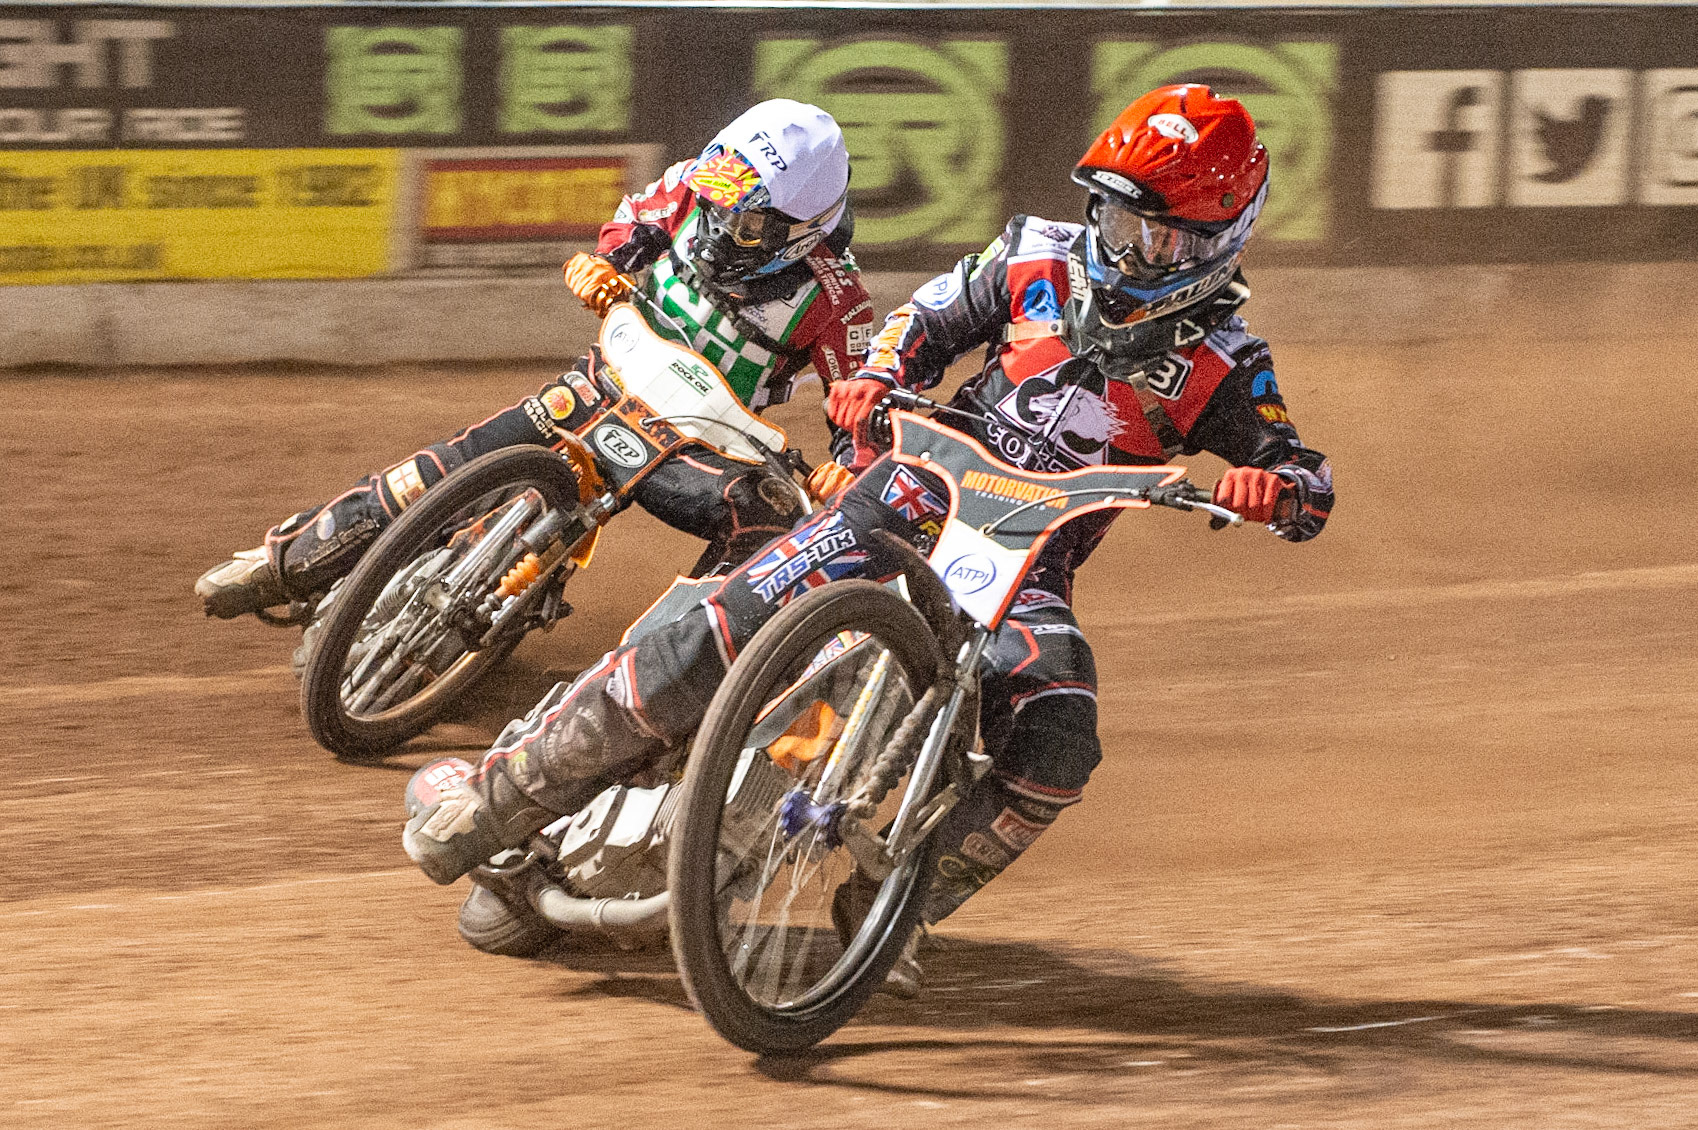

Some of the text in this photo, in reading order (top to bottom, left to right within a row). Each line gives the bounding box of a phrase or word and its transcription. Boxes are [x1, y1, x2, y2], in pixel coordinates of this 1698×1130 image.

[671, 362, 695, 381] ROCK
[1147, 359, 1177, 389] 3
[950, 566, 990, 584] ATPI
